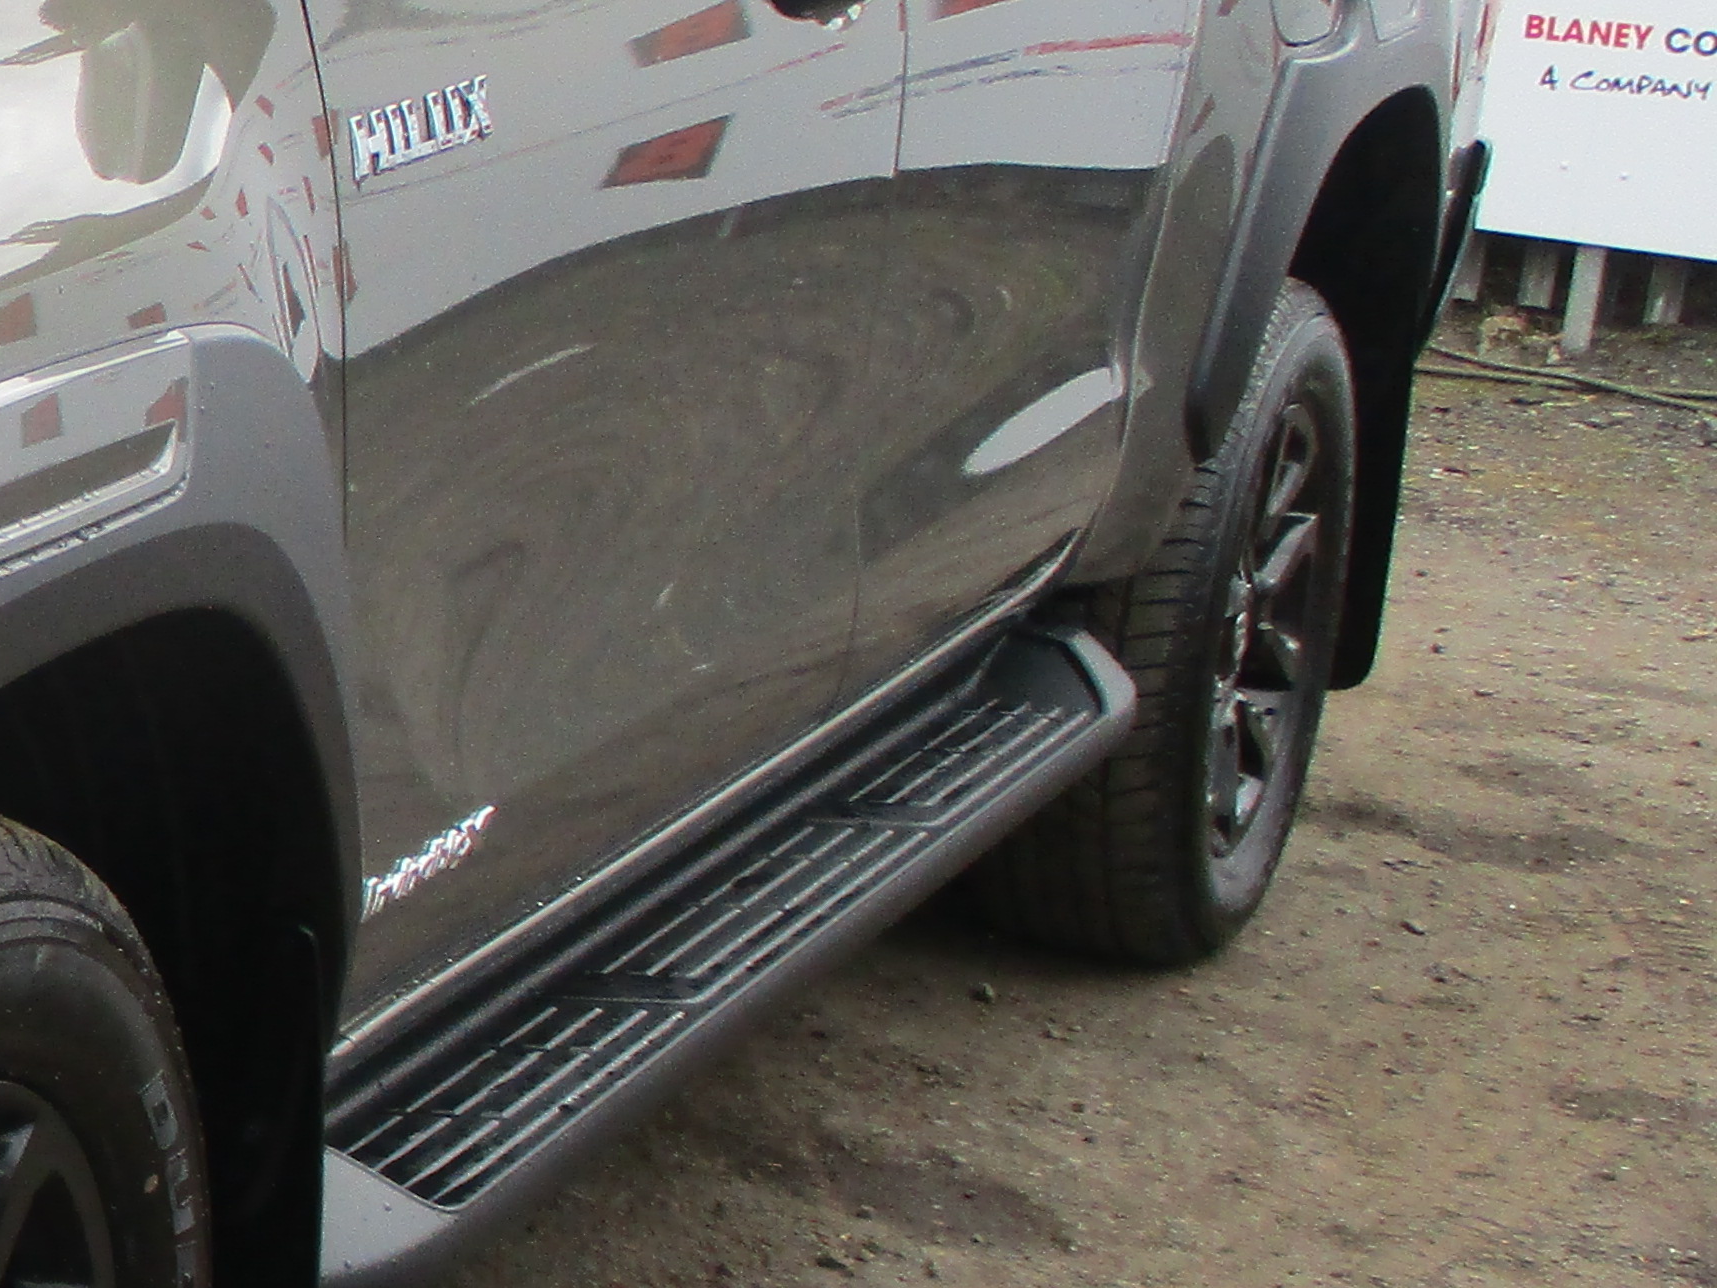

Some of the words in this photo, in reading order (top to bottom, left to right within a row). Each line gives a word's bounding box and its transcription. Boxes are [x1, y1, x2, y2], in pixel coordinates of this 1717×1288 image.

[1524, 14, 1655, 50] BLANEY
[1569, 70, 1713, 101] COMPANY
[348, 73, 495, 182] HILUX
